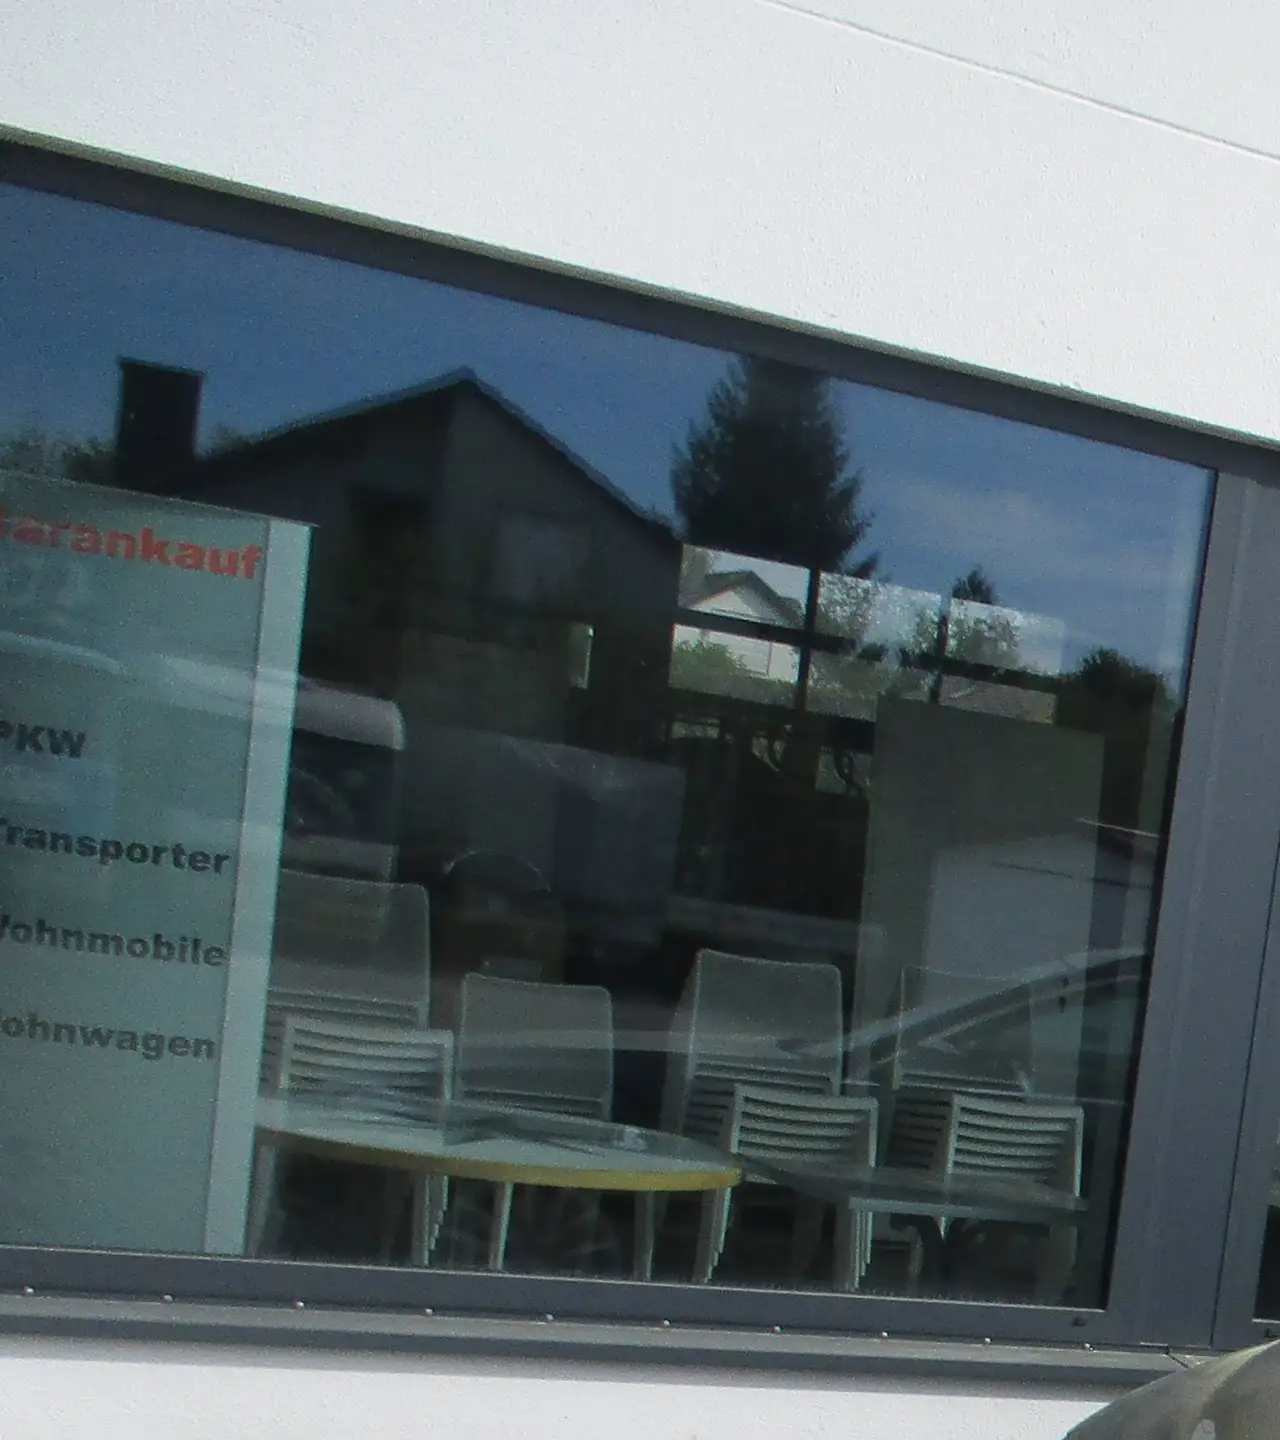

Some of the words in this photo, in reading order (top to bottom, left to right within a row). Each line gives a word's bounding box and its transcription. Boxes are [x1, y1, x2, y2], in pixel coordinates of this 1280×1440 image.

[0, 817, 231, 875] ransporter
[0, 914, 228, 967] ohnmobile
[0, 1013, 216, 1061] ohnwagen
